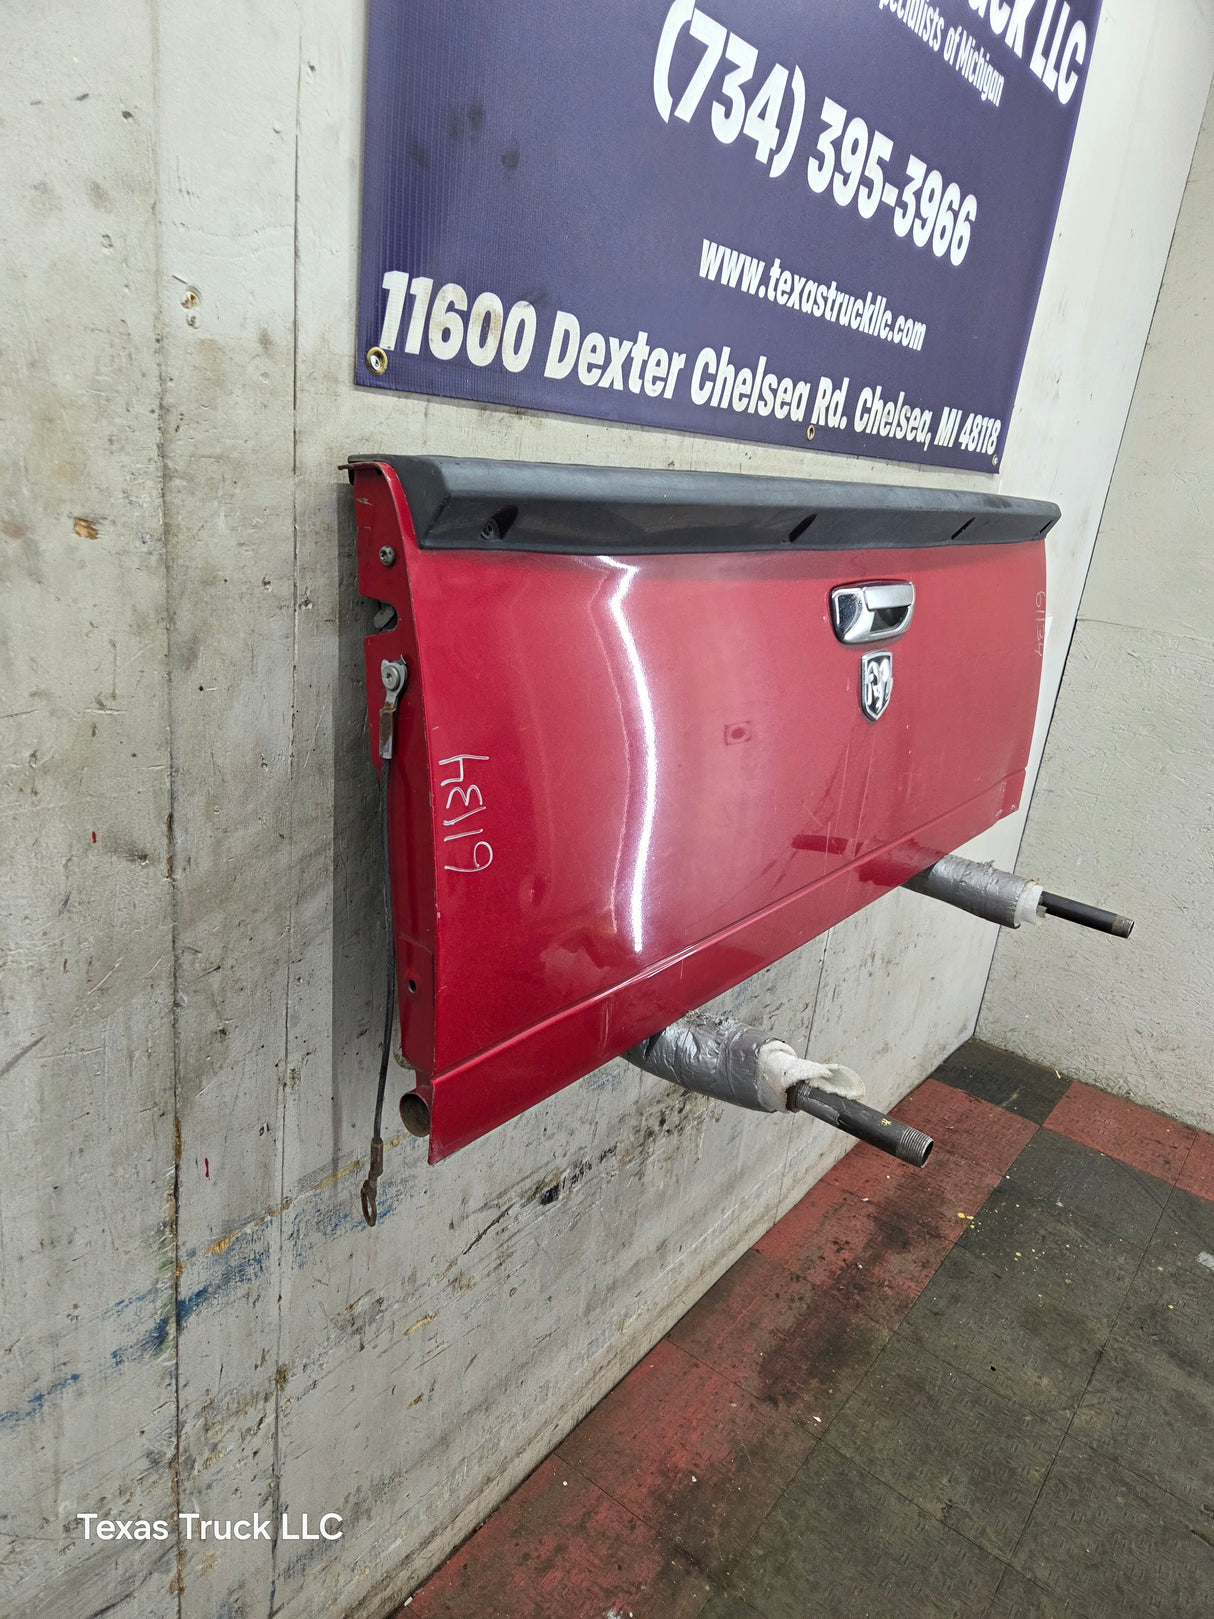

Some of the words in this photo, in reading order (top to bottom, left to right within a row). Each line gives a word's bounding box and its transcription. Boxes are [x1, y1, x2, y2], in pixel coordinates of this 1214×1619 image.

[943, 26, 963, 67] of
[955, 30, 1005, 108] Michigan
[1029, 0, 1087, 105] LLC
[653, 0, 806, 178] (734)
[807, 96, 978, 267] 395-3966
[699, 238, 927, 352] www.texastruckllc.com
[379, 270, 537, 373] 11600
[543, 310, 687, 399] Dexter
[690, 345, 812, 423] Chelsea
[810, 376, 850, 430] Rd.
[853, 385, 933, 452] Chelsea,
[933, 406, 963, 448] MI
[958, 412, 1002, 456] 48118
[438, 753, 494, 873] 61134
